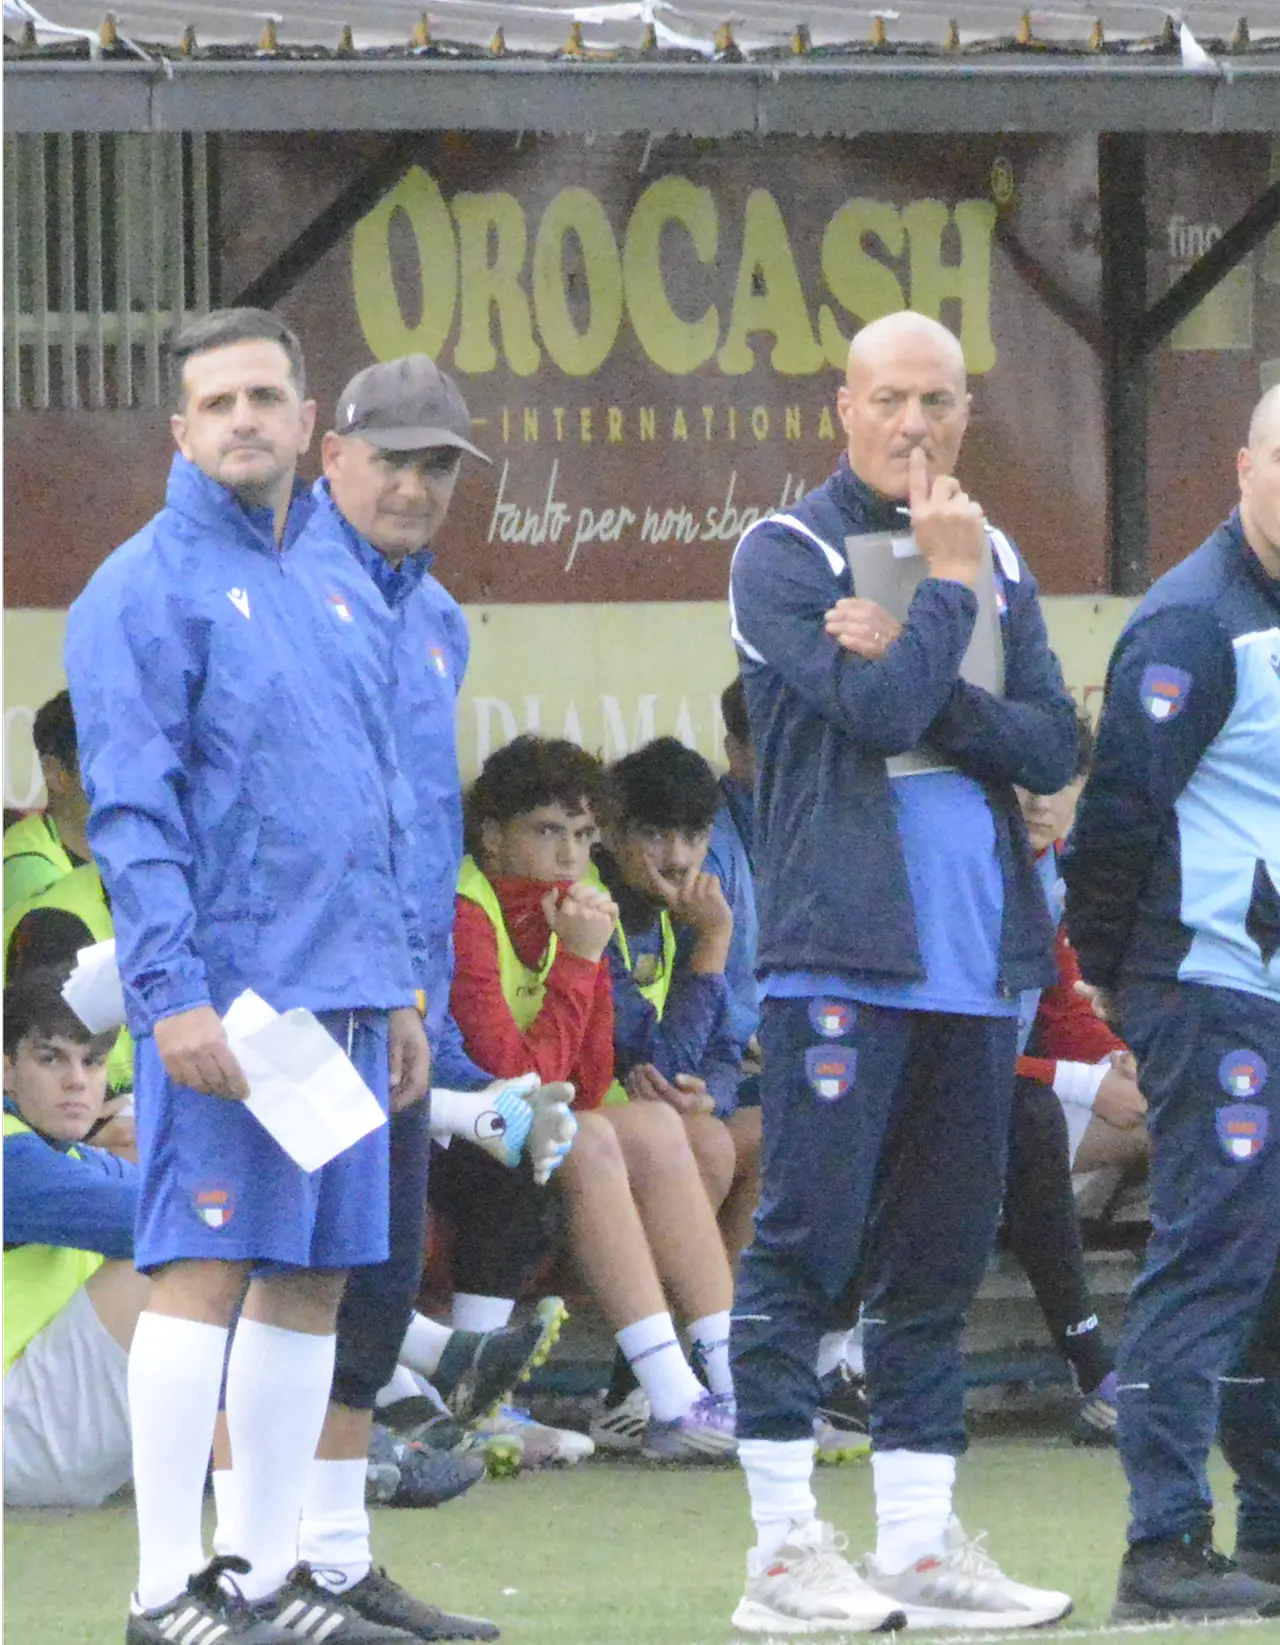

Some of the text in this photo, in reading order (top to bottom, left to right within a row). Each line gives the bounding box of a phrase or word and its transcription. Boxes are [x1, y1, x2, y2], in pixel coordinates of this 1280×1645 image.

[352, 165, 997, 376] OROCASH
[503, 405, 837, 443] INTERNATIONA
[565, 503, 636, 573] per
[641, 502, 701, 545] non
